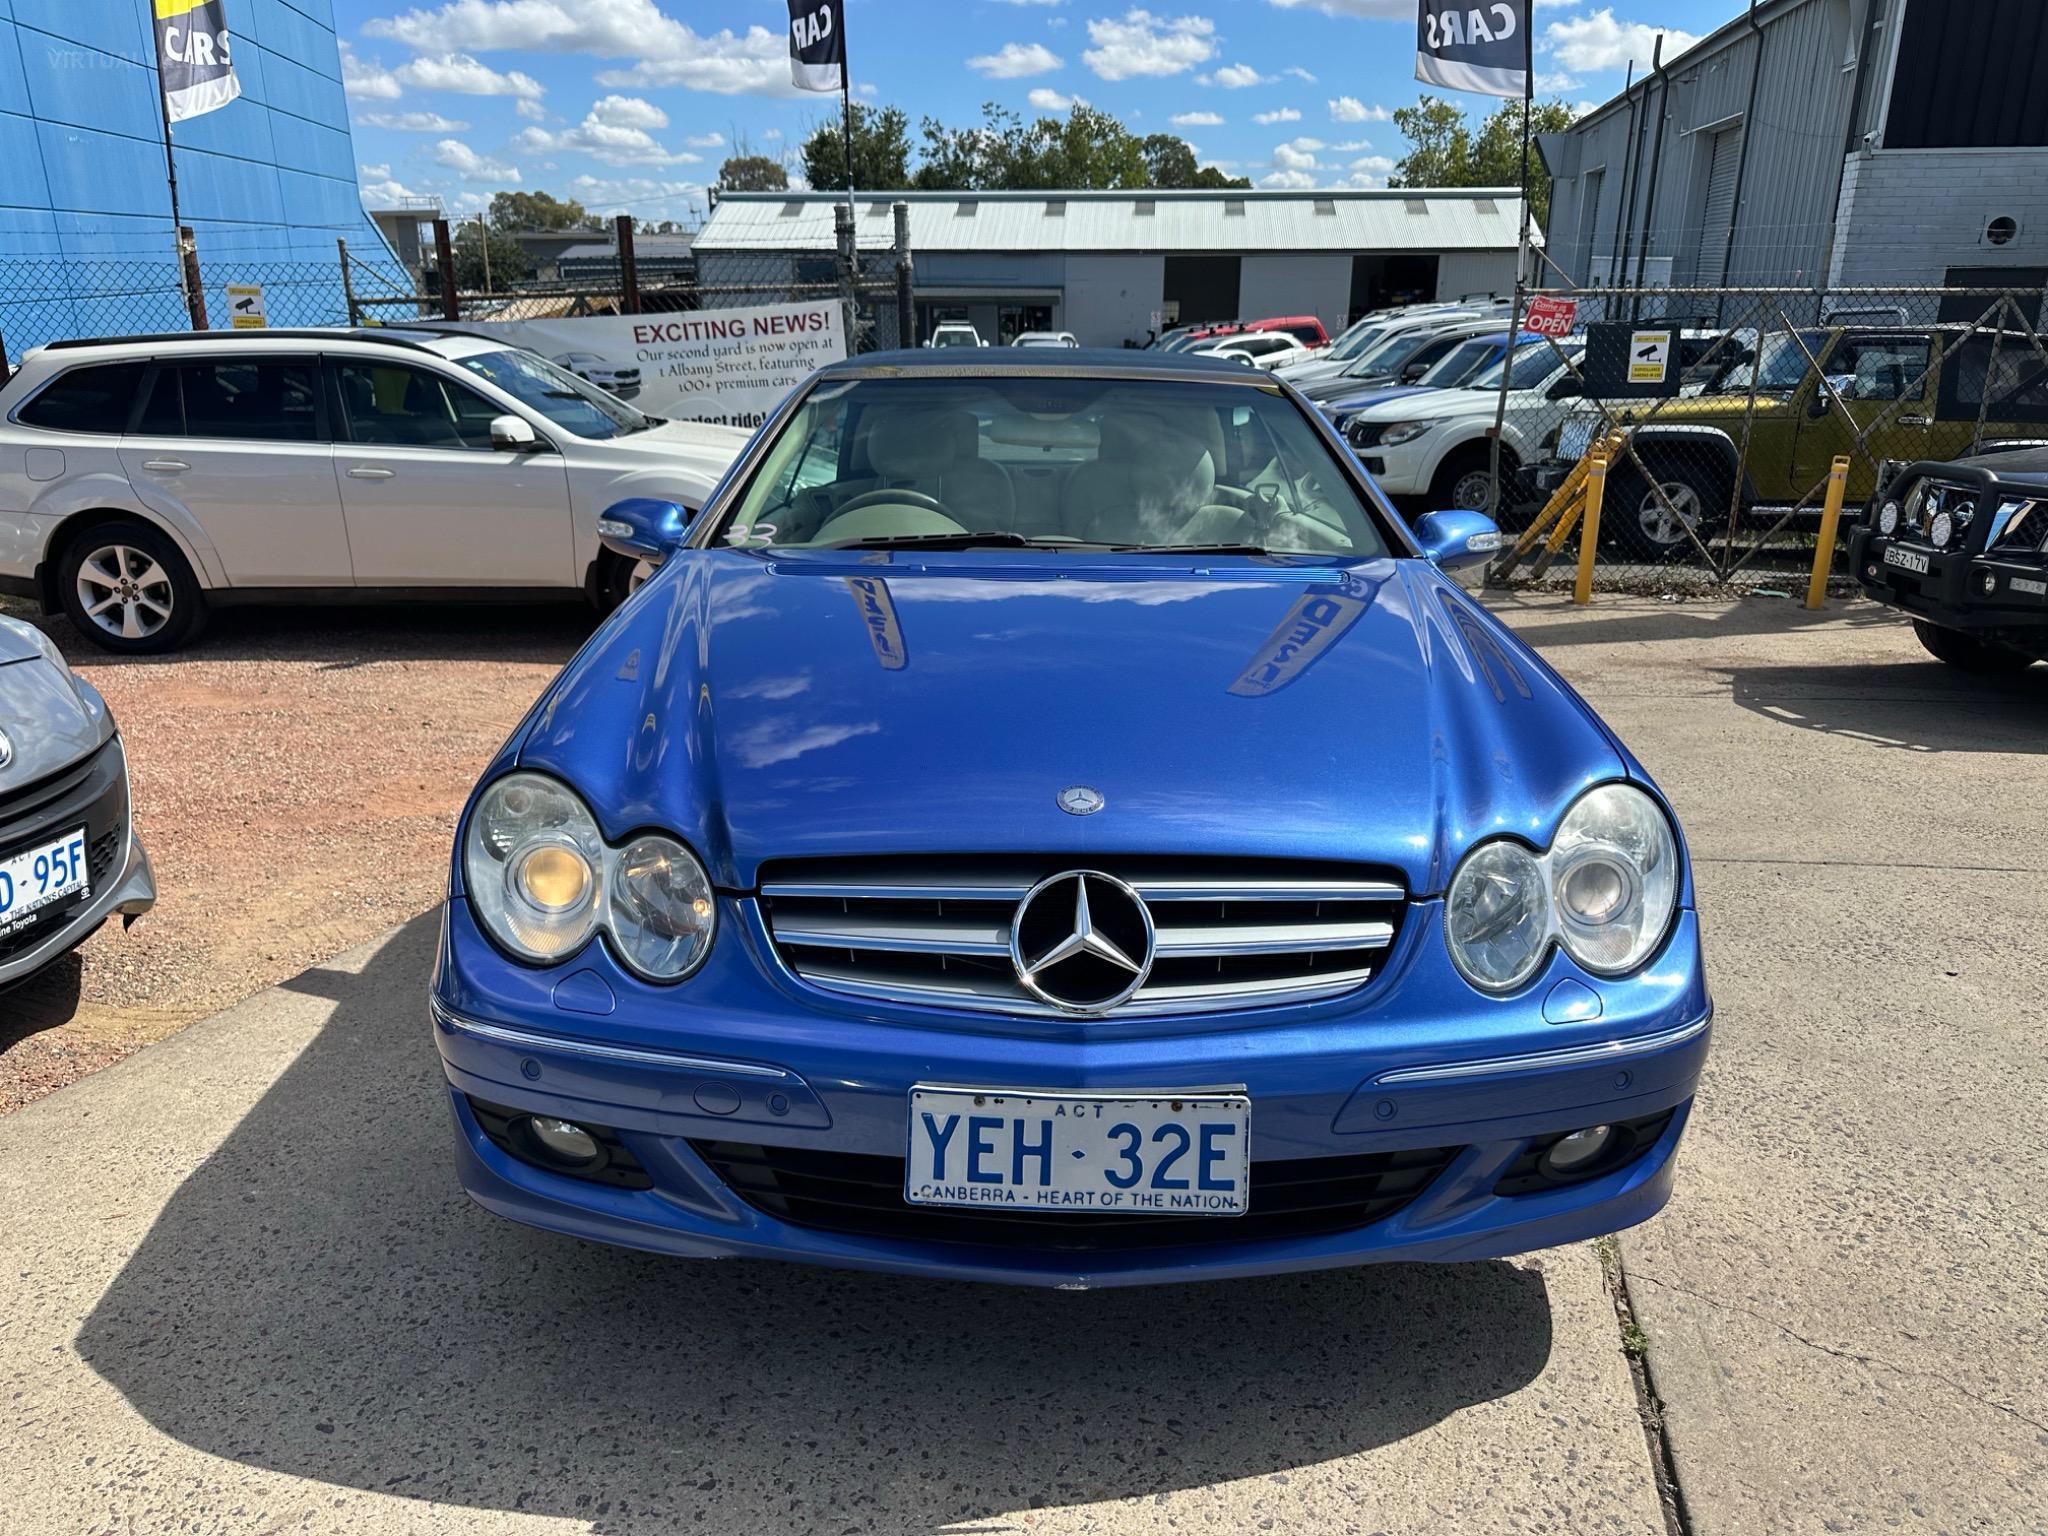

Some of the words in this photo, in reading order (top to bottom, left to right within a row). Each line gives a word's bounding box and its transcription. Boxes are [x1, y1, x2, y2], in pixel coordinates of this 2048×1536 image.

[165, 26, 230, 66] CARS
[633, 319, 746, 344] EXCITING
[753, 311, 830, 337] NEWS!
[1528, 314, 1572, 333] OPEN
[636, 349, 667, 363] Our
[667, 344, 710, 361] second
[713, 341, 743, 360] yard
[746, 341, 756, 354] is
[758, 341, 785, 354] now
[788, 339, 818, 355] open
[821, 337, 833, 349] at
[659, 368, 665, 378] 1
[664, 363, 713, 379] Albany
[716, 358, 757, 374] Street,
[759, 354, 815, 372] featuring
[679, 379, 711, 393] 100+
[716, 377, 769, 394] premium
[772, 376, 798, 387] cars
[712, 522, 778, 550] 33
[12, 913, 37, 930] Toyota
[1054, 1104, 1104, 1119] ACT
[920, 1184, 1016, 1203] CANBERRA
[1037, 1190, 1096, 1206] HEART
[1100, 1191, 1123, 1206] OF
[1132, 1192, 1164, 1208] THE
[1170, 1194, 1234, 1210] NATION
